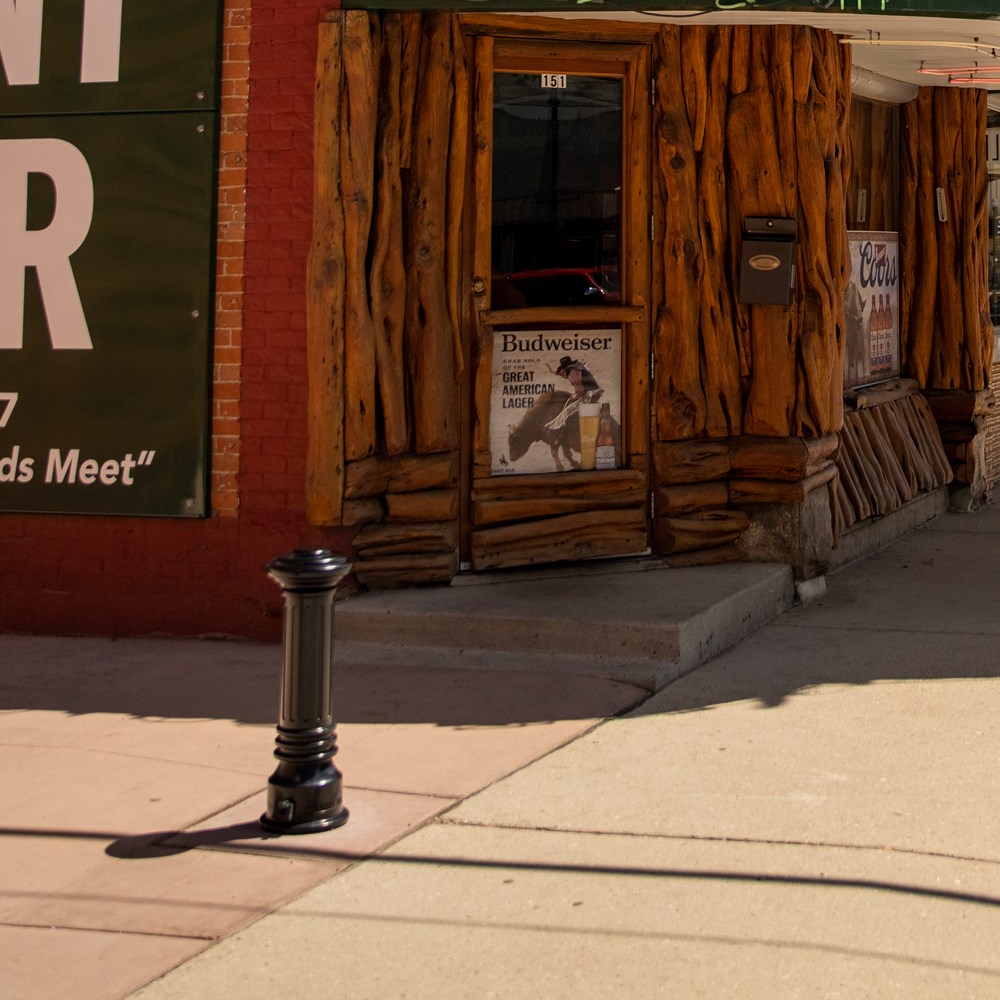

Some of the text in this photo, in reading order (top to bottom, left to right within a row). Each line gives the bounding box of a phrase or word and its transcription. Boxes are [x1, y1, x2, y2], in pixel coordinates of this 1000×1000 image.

[543, 74, 565, 88] 151
[859, 241, 897, 288] Coors
[501, 333, 612, 352] Budweiser
[502, 371, 535, 382] GREAT
[502, 383, 555, 396] AMERICAN
[502, 397, 535, 409] LAGER
